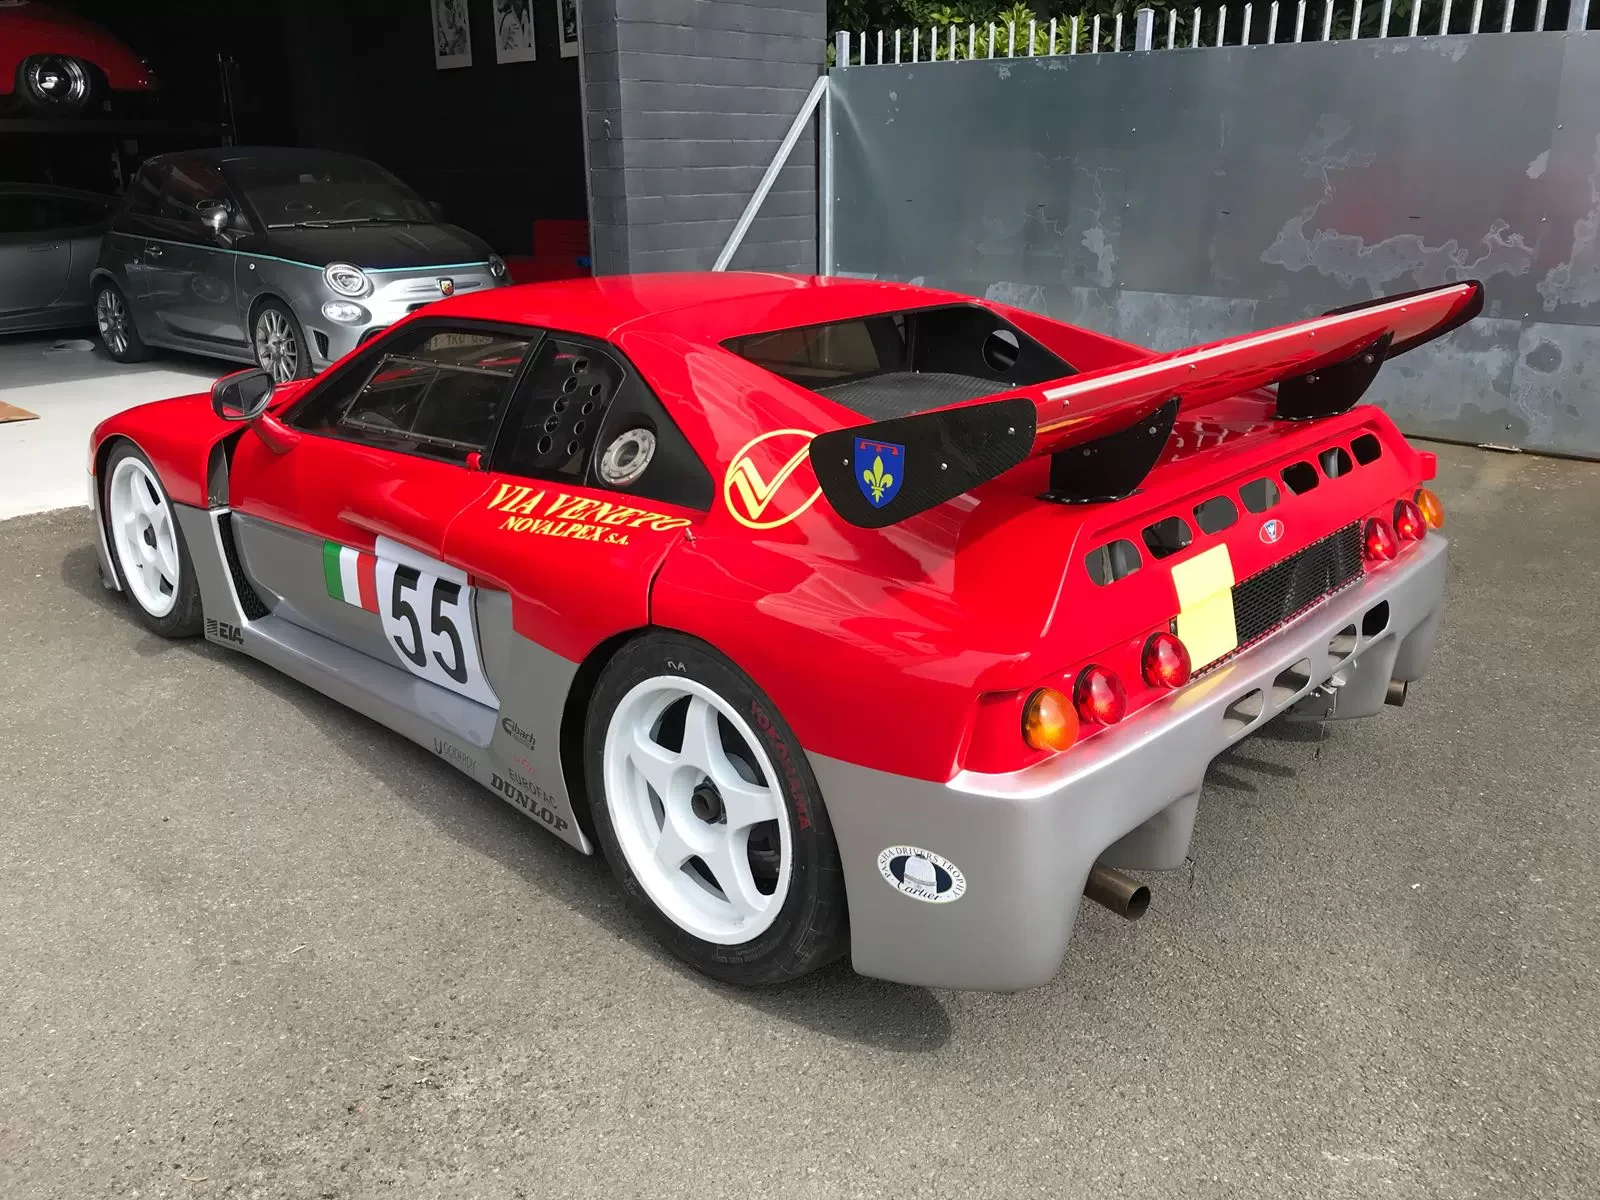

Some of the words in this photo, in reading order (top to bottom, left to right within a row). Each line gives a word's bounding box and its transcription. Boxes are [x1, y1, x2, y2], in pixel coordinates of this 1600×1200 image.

[487, 483, 546, 515] VIA
[544, 493, 692, 532] VENETO
[498, 516, 611, 541] NOVALPEX
[604, 532, 629, 545] S.A.
[392, 564, 468, 684] 55
[490, 772, 568, 832] DUNLOP
[880, 849, 895, 878] PASHA
[895, 847, 939, 863] DRIVERS
[941, 860, 965, 898] TROPHY
[897, 881, 939, 901] Cartier
